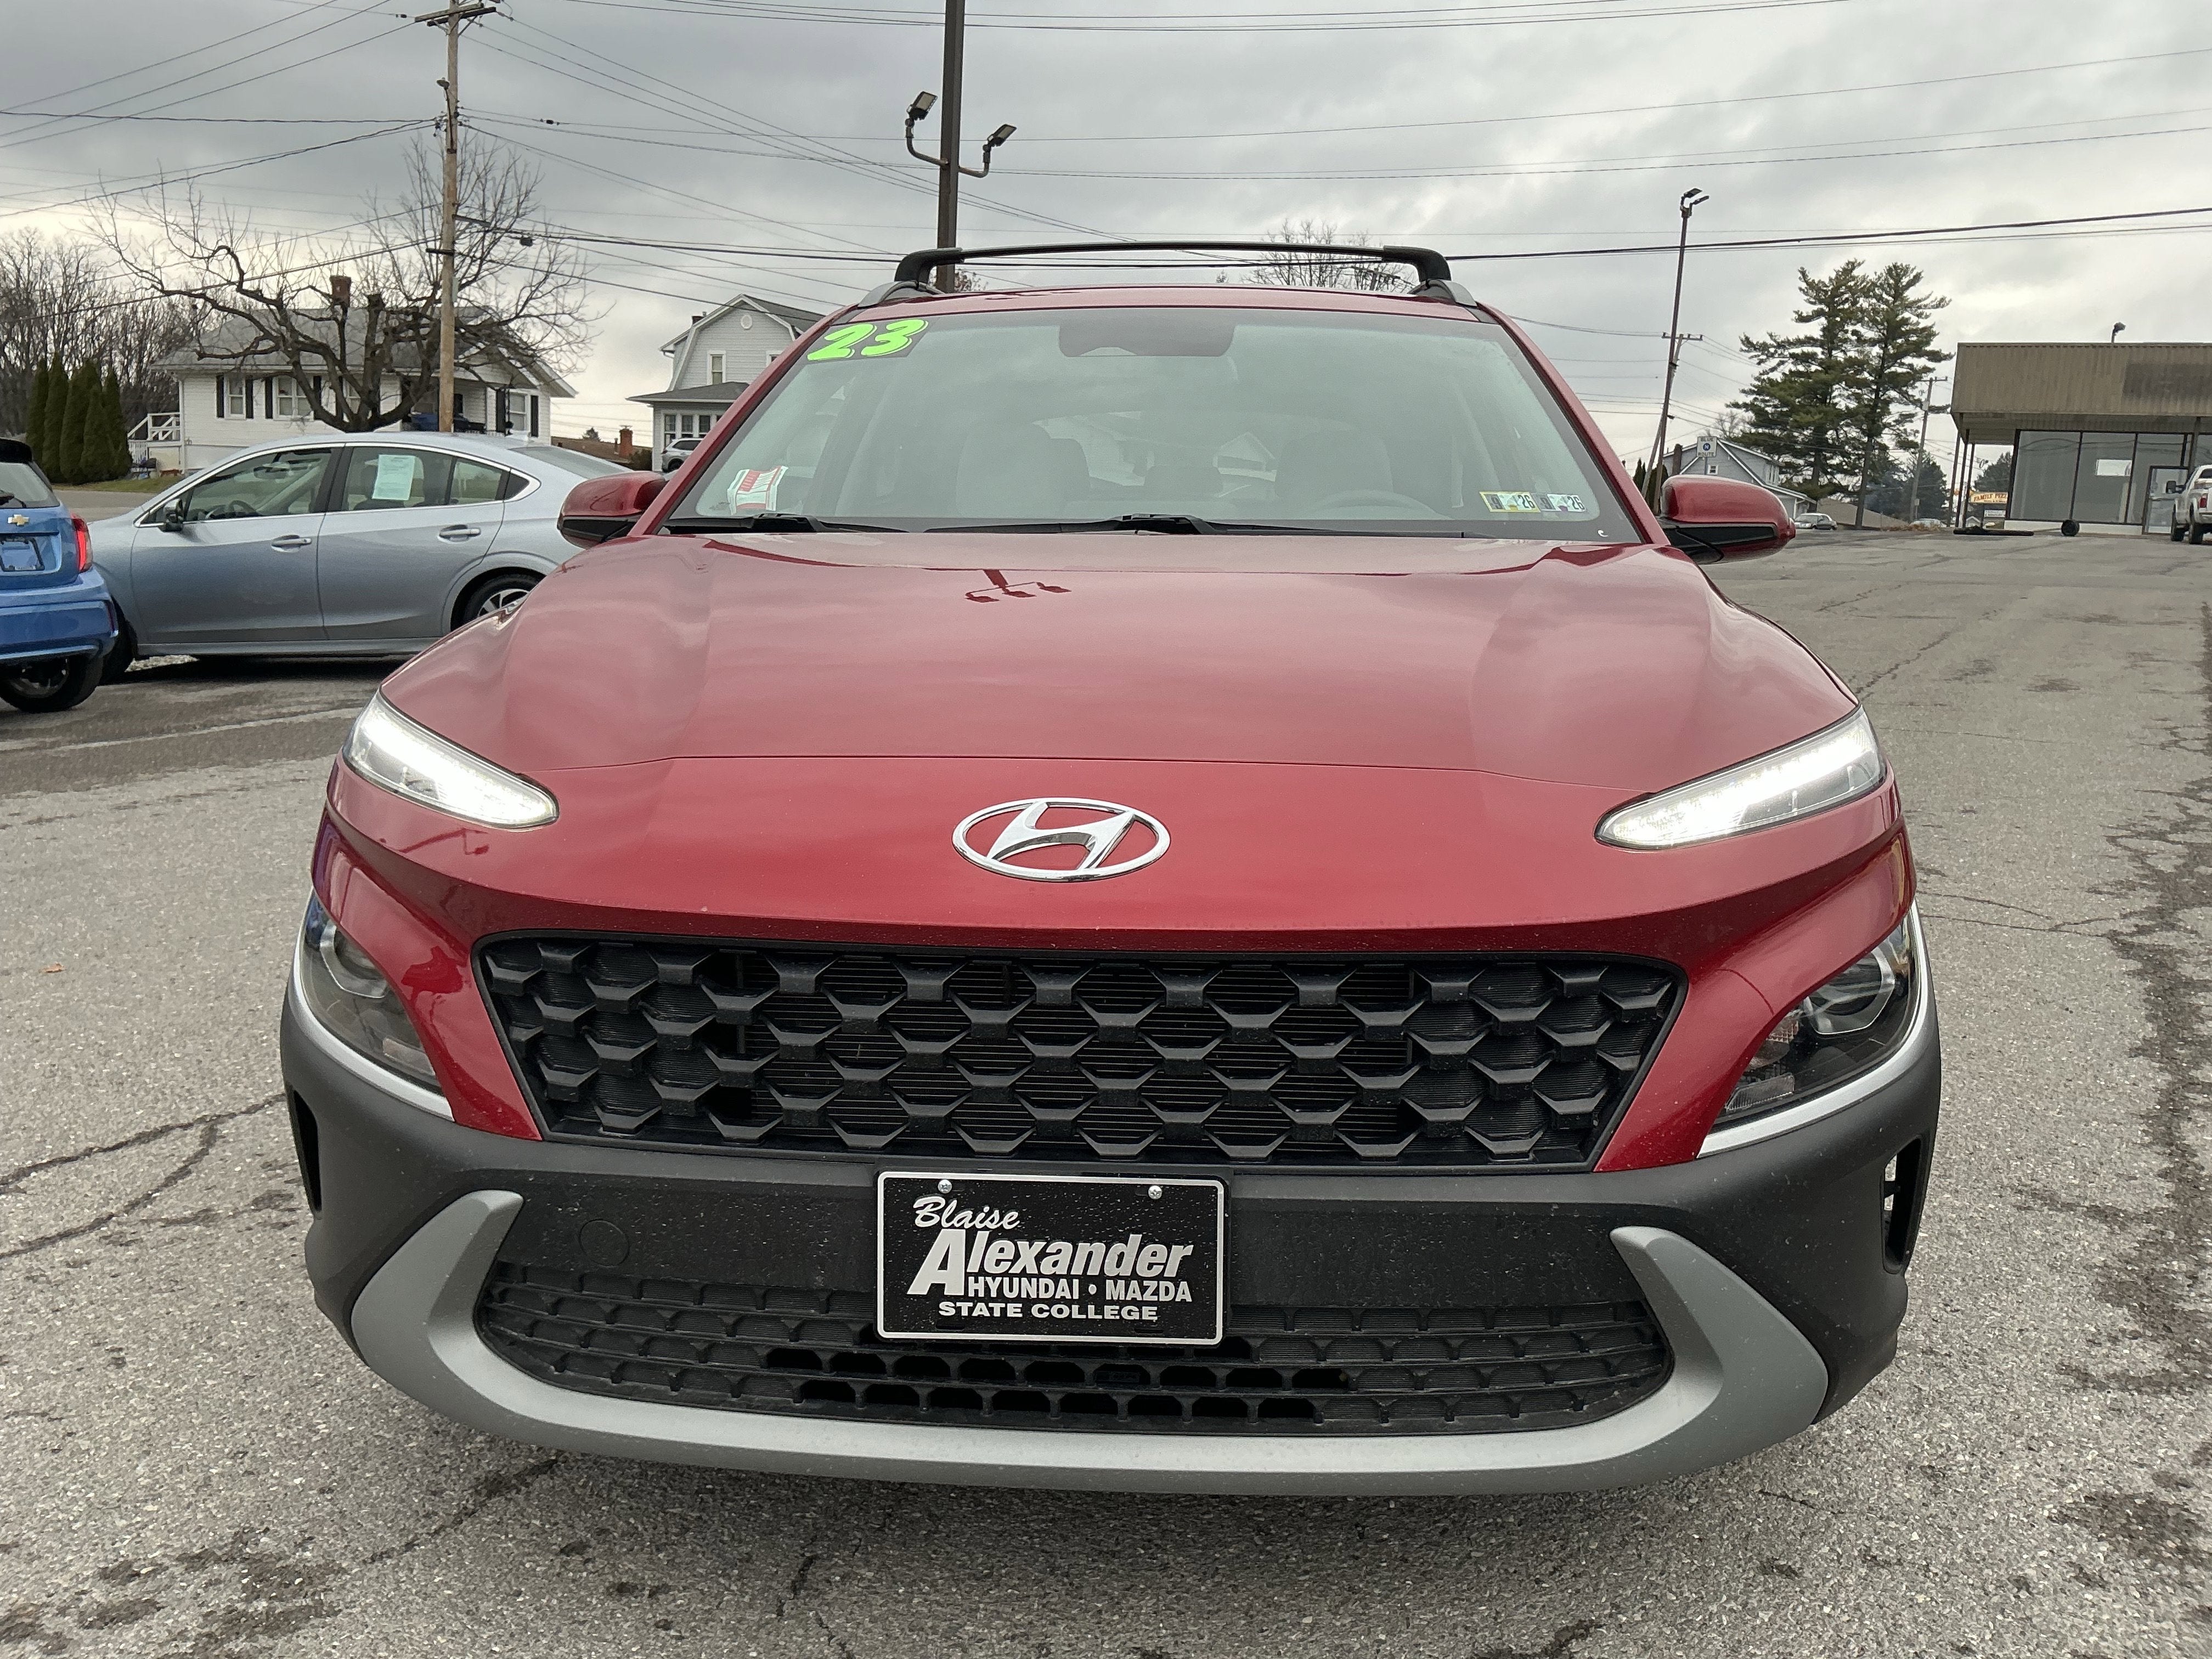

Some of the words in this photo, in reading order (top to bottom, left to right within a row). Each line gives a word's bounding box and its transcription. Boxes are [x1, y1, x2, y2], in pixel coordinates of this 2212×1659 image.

[807, 319, 928, 360] 23
[1517, 494, 1536, 509] 26
[1567, 496, 1585, 510] 26
[913, 1196, 1020, 1230] Blaise
[907, 1229, 1194, 1295] Alexander
[968, 1277, 1079, 1300] HYUNDAI
[1105, 1279, 1193, 1302] MAZDA
[939, 1301, 1023, 1318] STATE
[1031, 1304, 1158, 1321] COLLEGE
